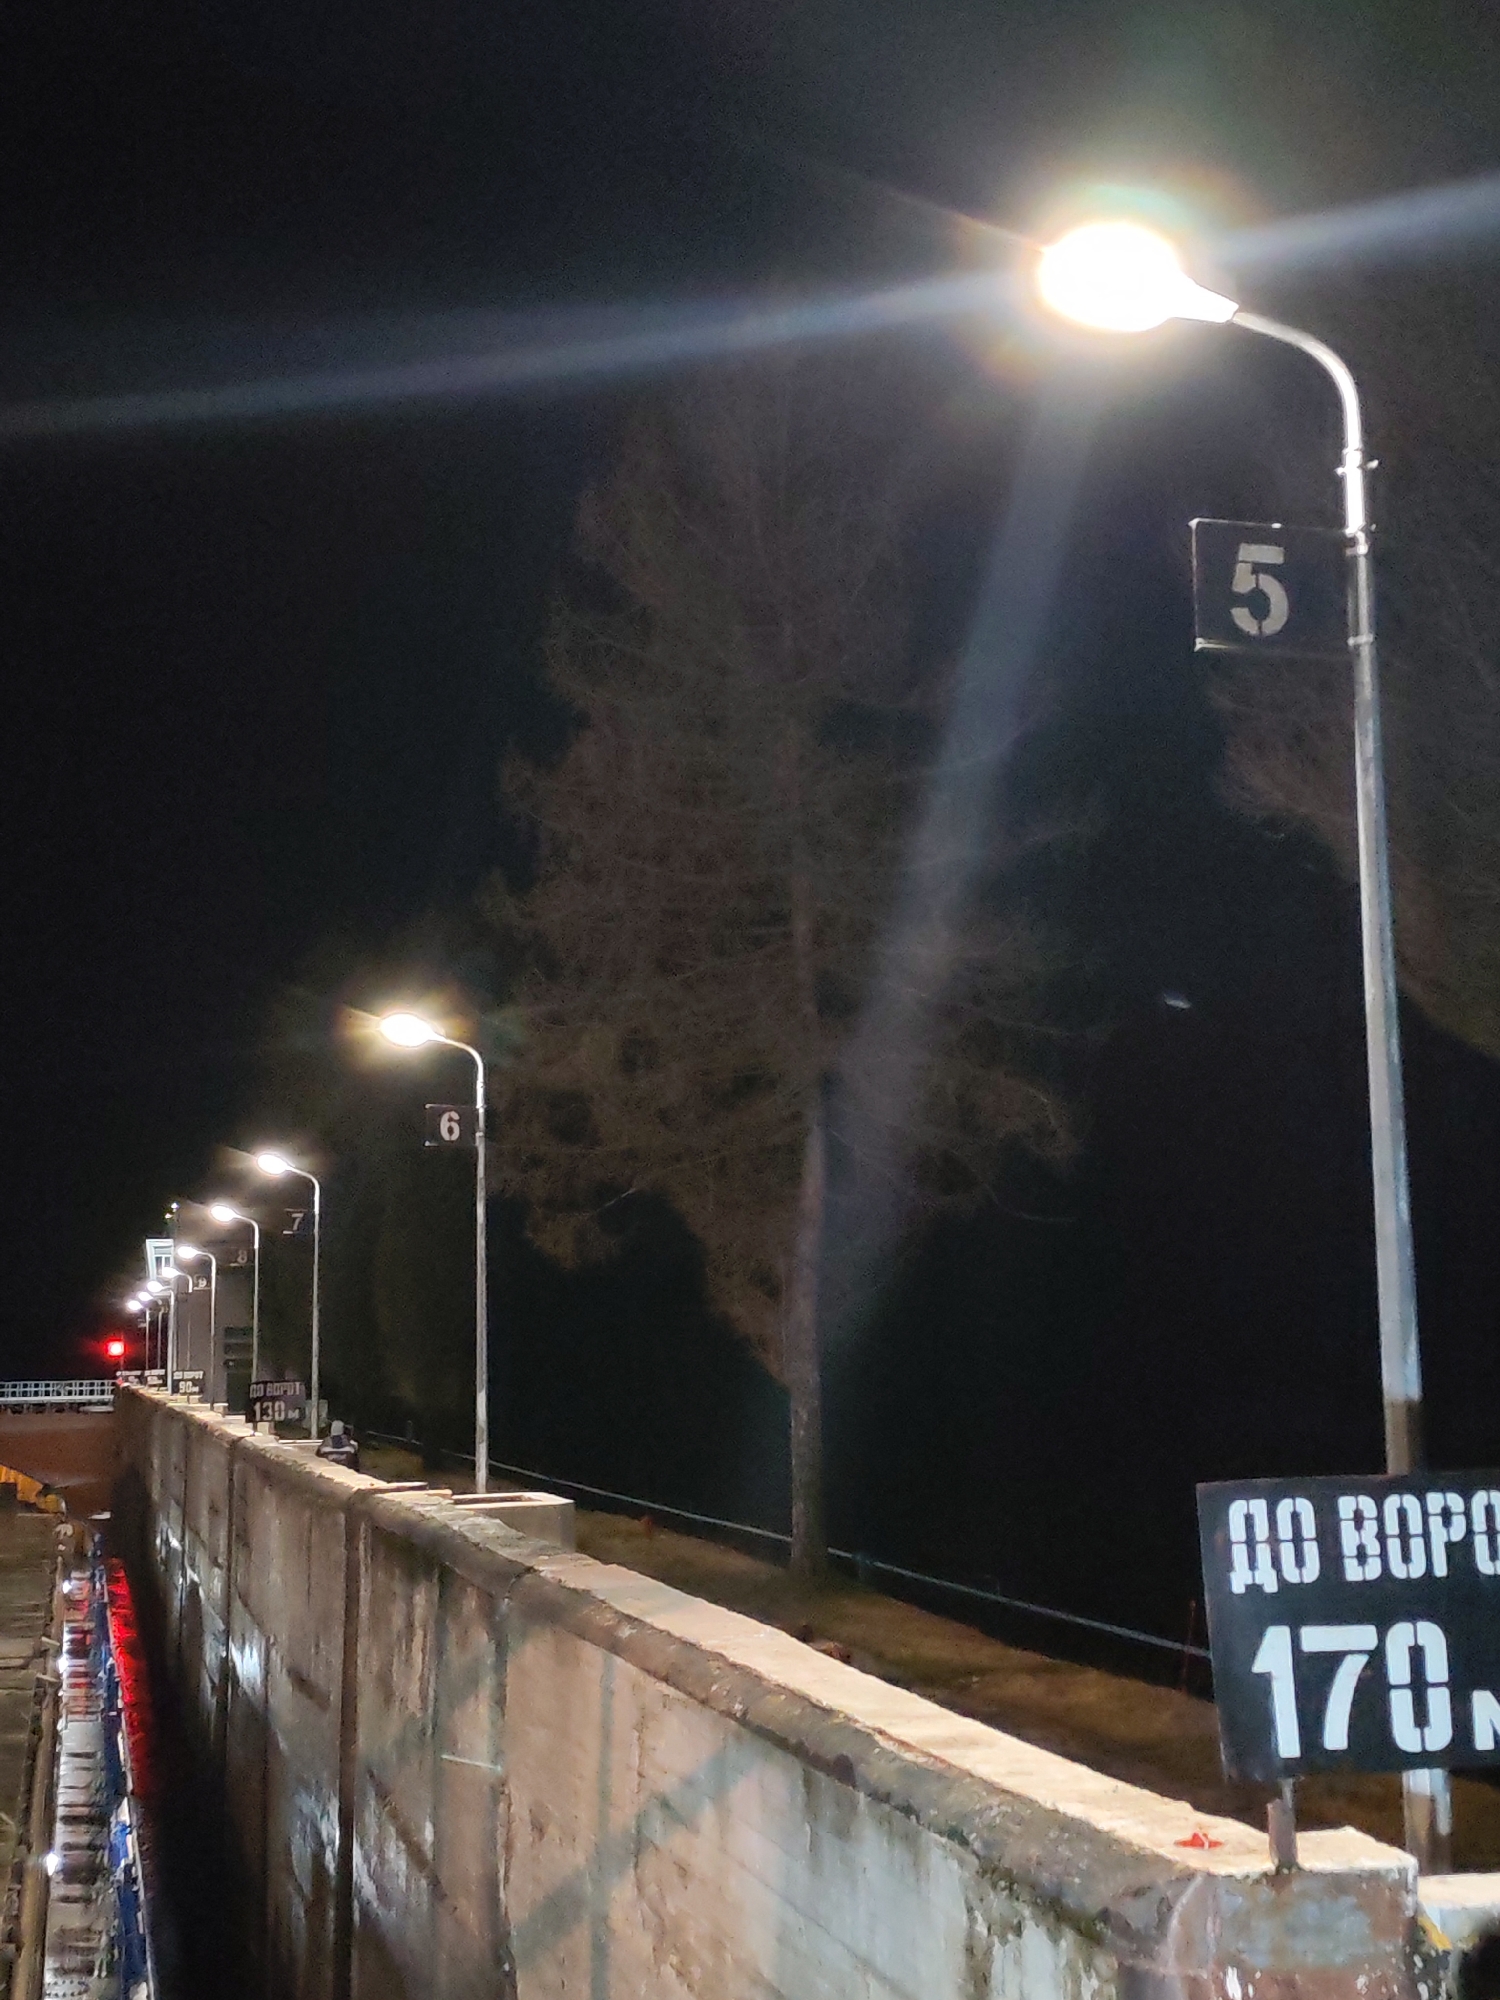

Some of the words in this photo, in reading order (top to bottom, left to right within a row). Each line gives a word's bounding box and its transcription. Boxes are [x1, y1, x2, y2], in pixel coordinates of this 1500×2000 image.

[1230, 543, 1289, 637] 5
[440, 1111, 460, 1141] 6
[291, 1213, 304, 1231] 7
[179, 1381, 192, 1393] 90
[254, 1400, 285, 1421] 130
[1229, 1497, 1320, 1594] ДО
[1252, 1621, 1453, 1758] 170
